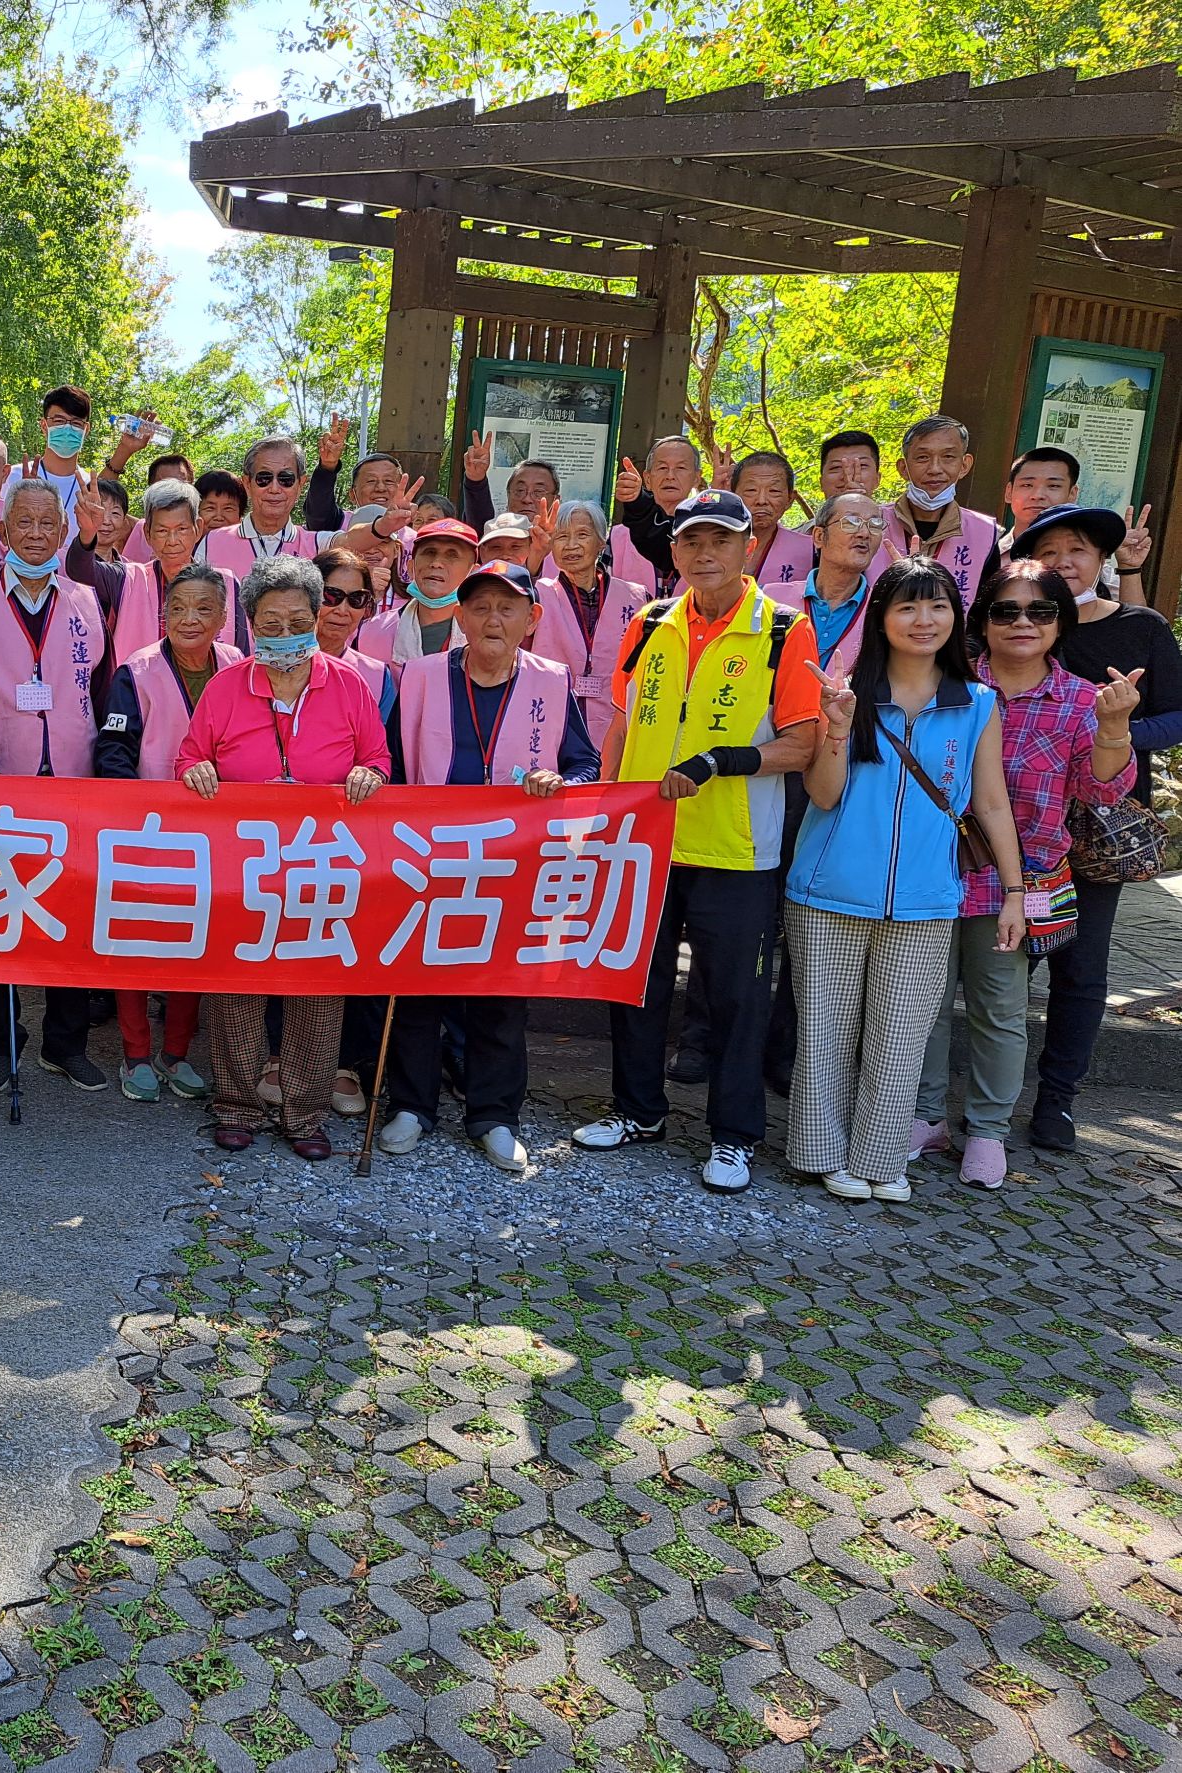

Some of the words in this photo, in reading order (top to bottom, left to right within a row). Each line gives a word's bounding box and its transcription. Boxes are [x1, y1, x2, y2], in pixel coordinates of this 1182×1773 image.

[68, 617, 91, 719] 花蓮榮家
[639, 653, 665, 726] 花蓮縣
[708, 684, 737, 731] 志工
